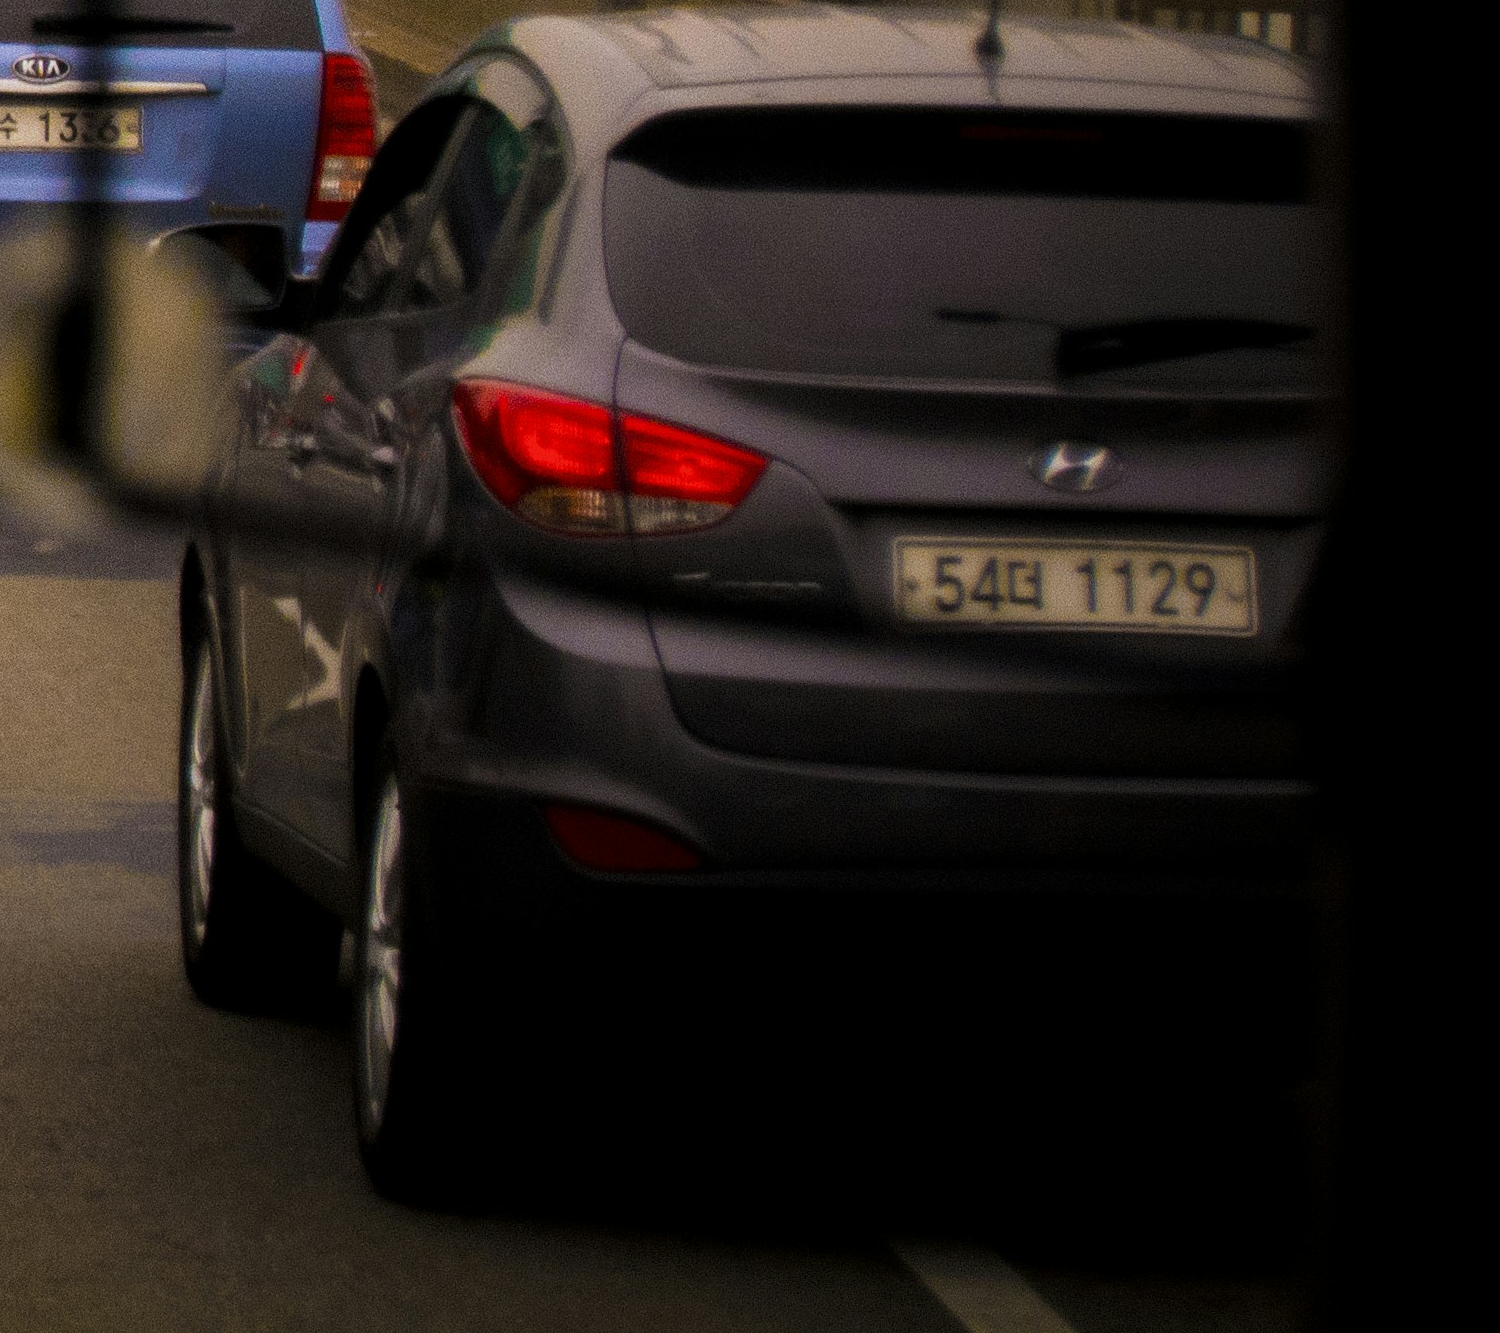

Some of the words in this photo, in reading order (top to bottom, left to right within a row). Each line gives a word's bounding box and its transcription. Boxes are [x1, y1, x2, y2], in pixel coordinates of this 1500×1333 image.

[22, 59, 61, 75] KIA
[933, 555, 1044, 613] 54더
[1076, 558, 1218, 618] 1129
